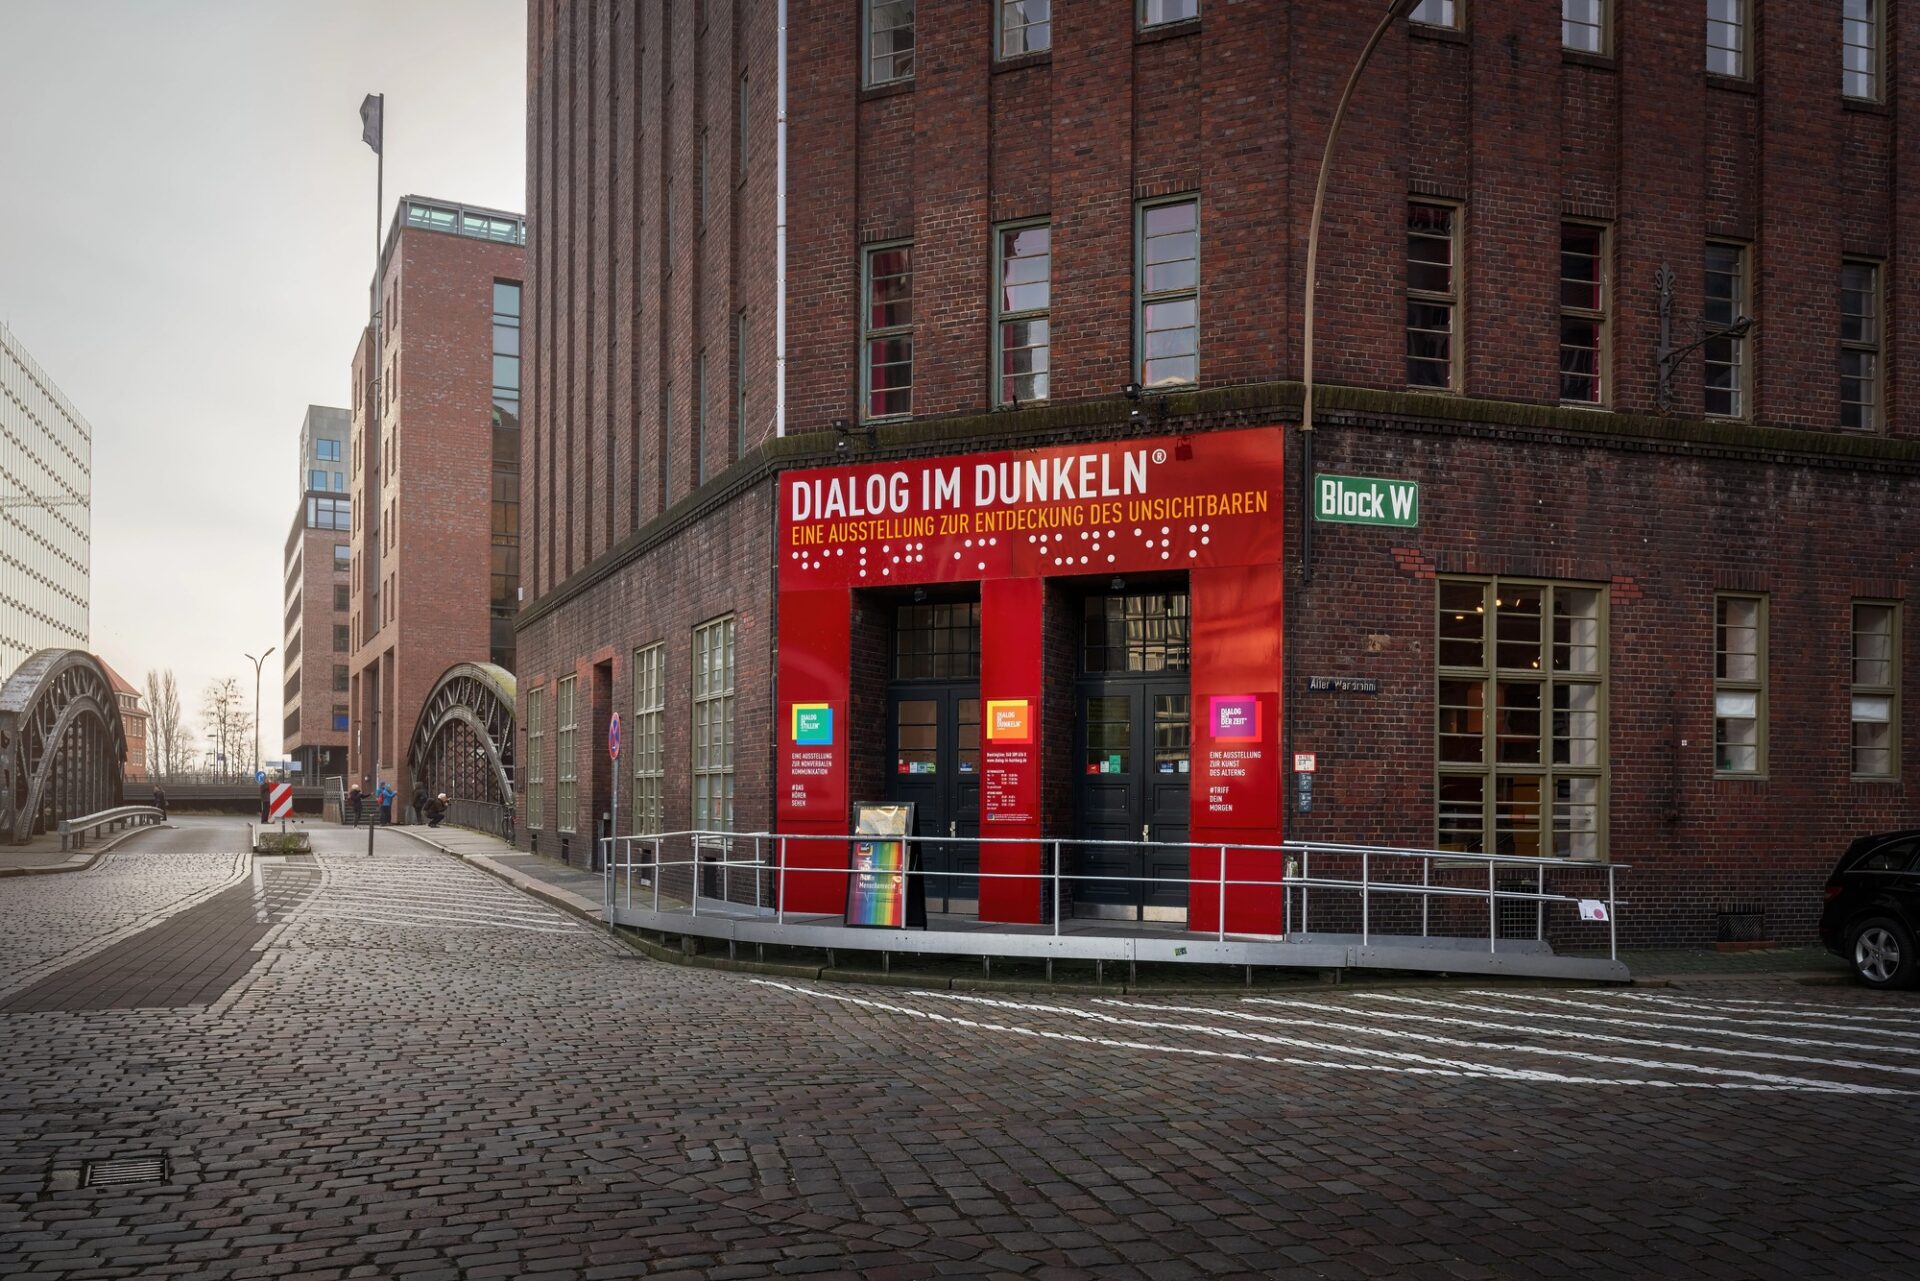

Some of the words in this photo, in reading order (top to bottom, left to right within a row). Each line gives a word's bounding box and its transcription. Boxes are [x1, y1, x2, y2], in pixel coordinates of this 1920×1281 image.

[792, 471, 909, 521] DIALOG
[922, 467, 960, 511] IM
[1321, 479, 1385, 518] Block
[1389, 484, 1415, 520] W
[792, 524, 824, 546] EINE
[828, 516, 935, 544] AUSSTELLUNG
[939, 512, 970, 536] ZUR
[975, 505, 1084, 533] ENTDECKUNG
[1090, 502, 1123, 526] DES
[1128, 489, 1268, 522] UNSICHTBAREN
[997, 711, 1016, 719] DIALOG
[1221, 707, 1242, 715] DIALOG
[792, 752, 802, 760] EINE
[802, 752, 832, 760] AUSSTELLUNG
[1209, 751, 1222, 759] EINE
[1223, 751, 1261, 759] AUSSTELLUNG
[1209, 760, 1220, 768] ZUR
[1221, 760, 1239, 768] KUNST
[792, 768, 828, 776] KOMMUNIKATION
[1209, 768, 1220, 777] DES
[1221, 768, 1246, 777] ALTERNS
[1209, 786, 1229, 794] #TRIFF
[1209, 795, 1222, 803] DEIN
[1209, 804, 1232, 812] MORGEN
